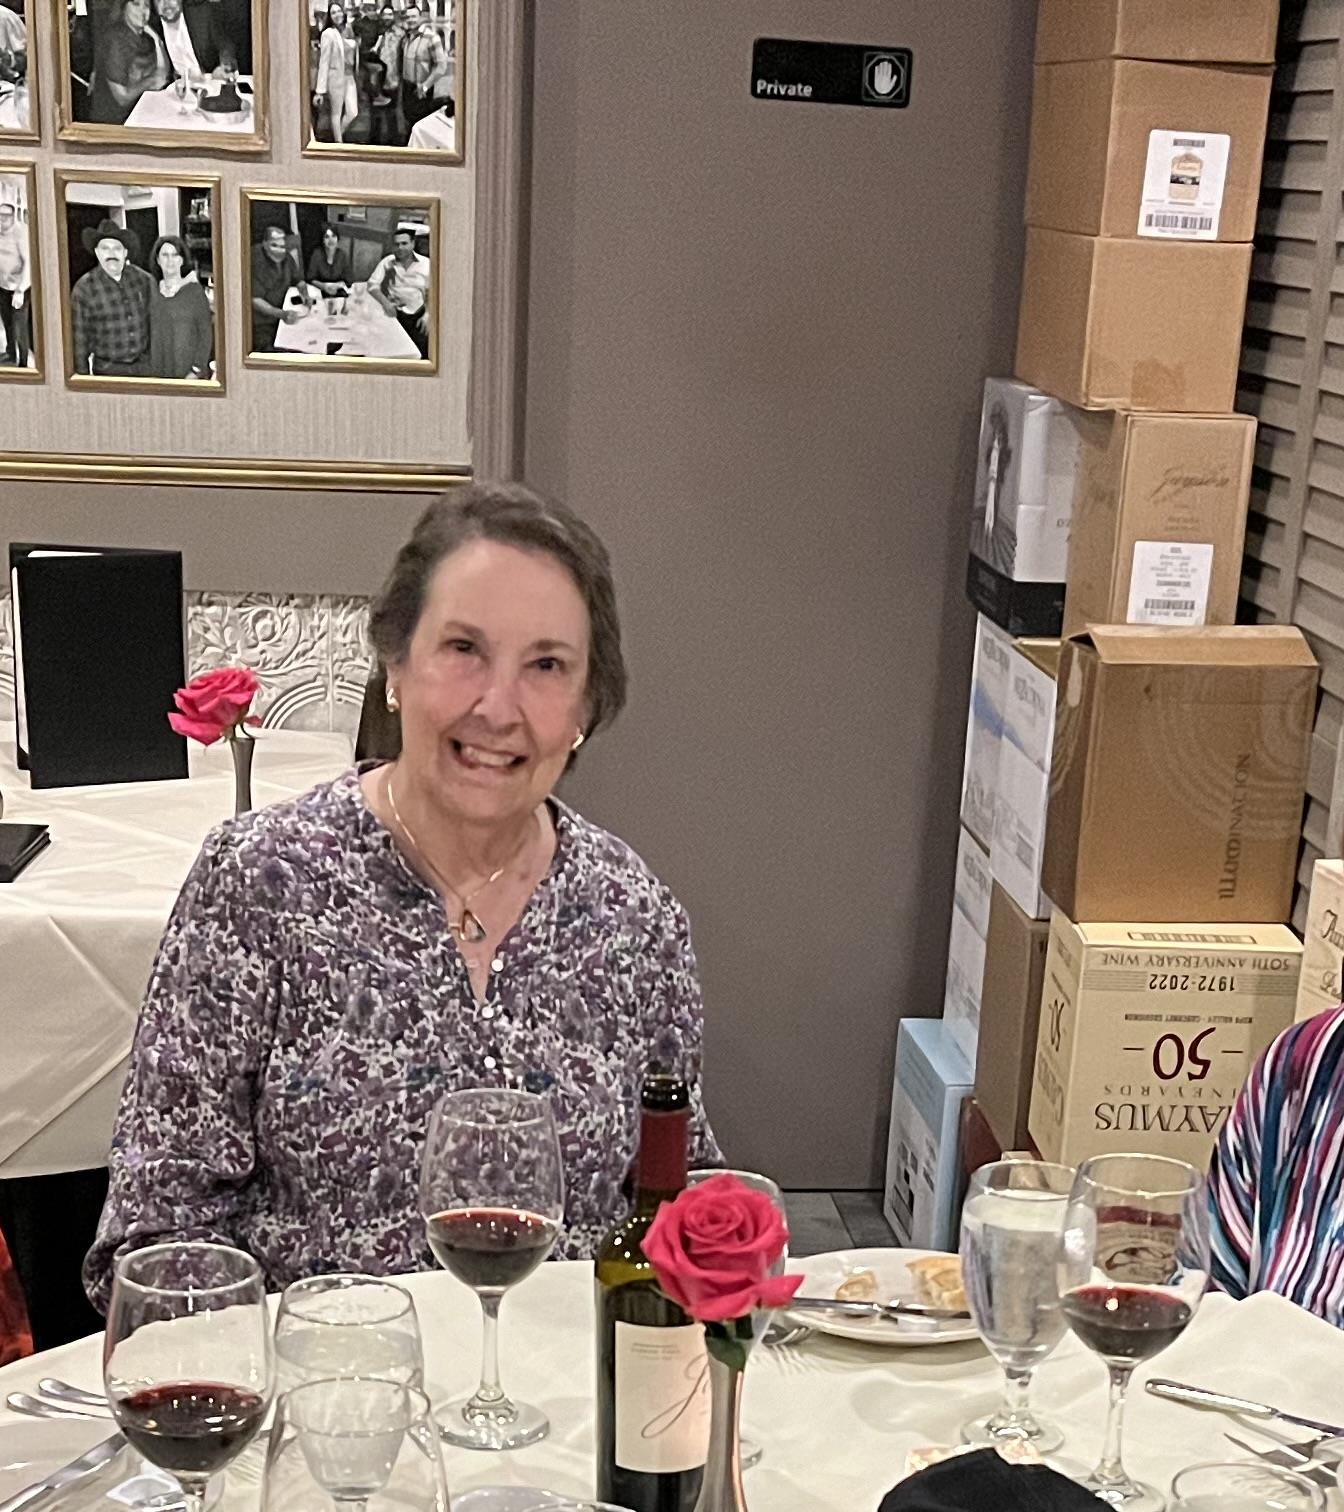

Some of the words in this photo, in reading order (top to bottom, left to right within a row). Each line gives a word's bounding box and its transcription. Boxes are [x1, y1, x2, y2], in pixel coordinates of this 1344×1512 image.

[756, 79, 813, 97] Private
[1103, 953, 1139, 966] WINE
[1144, 954, 1246, 968] ANNIVERSARY
[1149, 974, 1235, 992] 1972-2022
[1152, 1027, 1216, 1081] 50
[1104, 1084, 1236, 1098] INEYARDS
[1094, 1103, 1233, 1134] AYMUS
